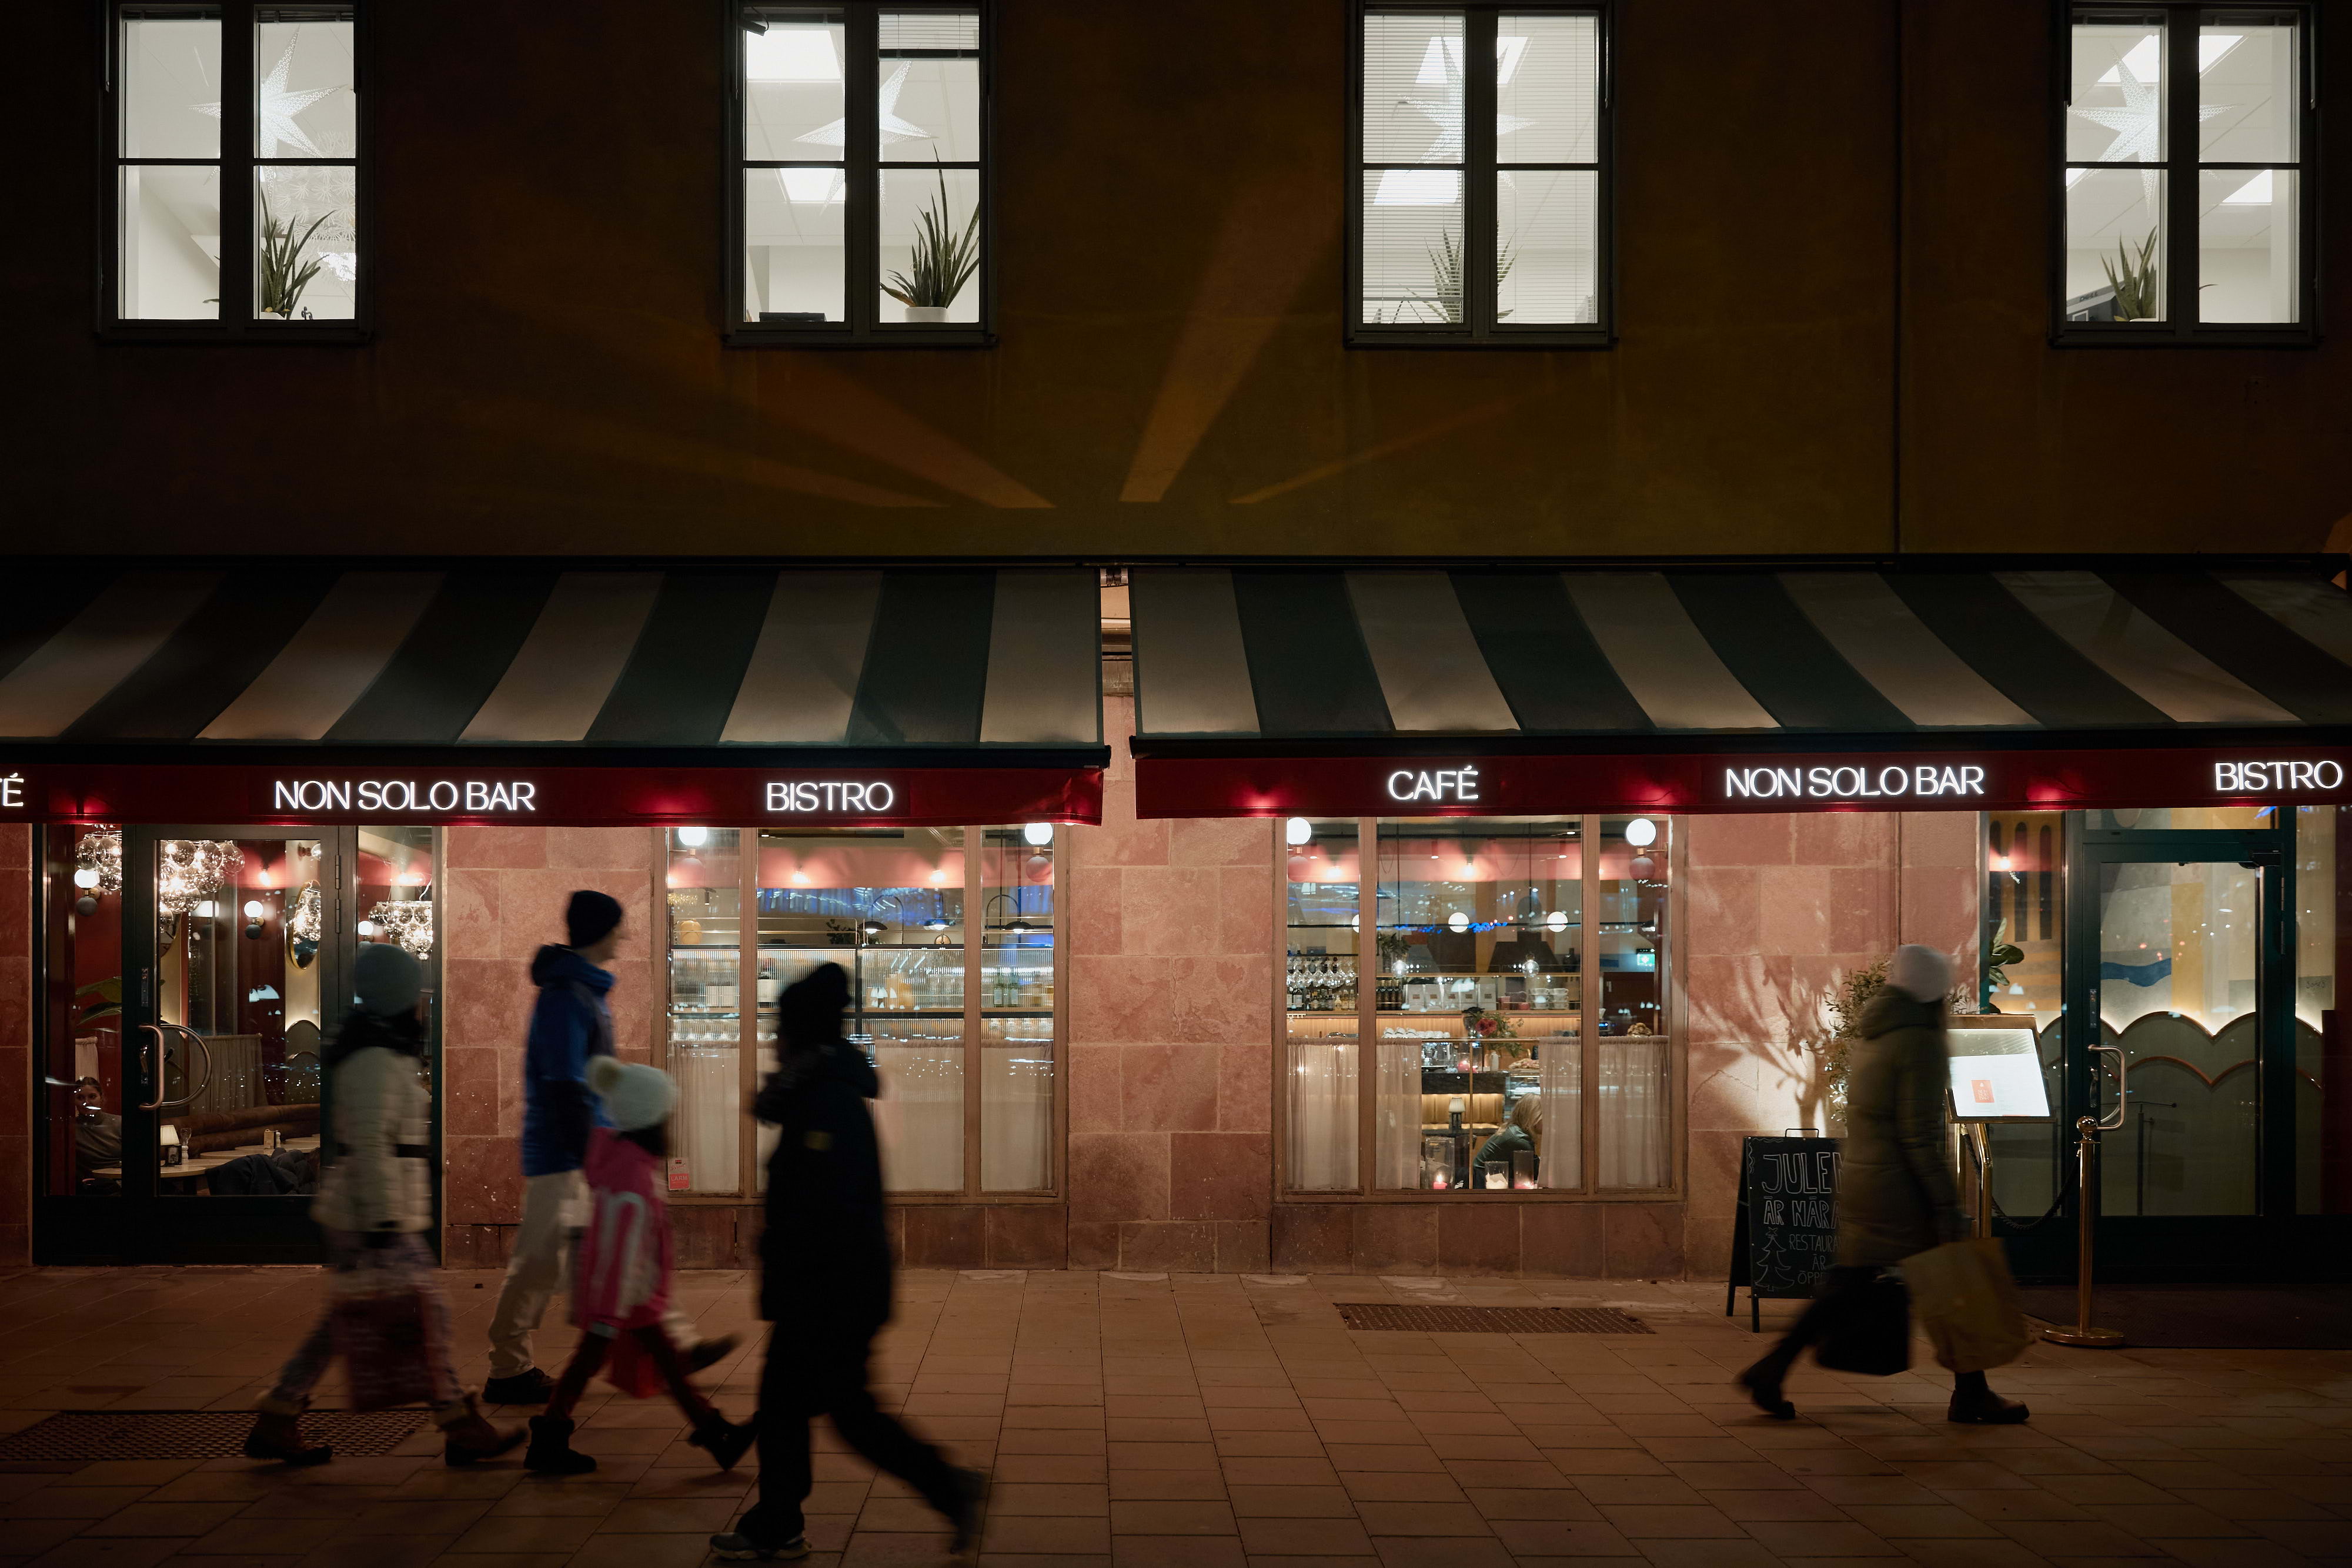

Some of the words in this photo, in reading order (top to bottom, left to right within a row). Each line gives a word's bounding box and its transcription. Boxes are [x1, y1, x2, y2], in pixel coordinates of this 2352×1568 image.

[1387, 765, 1479, 801] CAFÉ
[1726, 768, 1801, 797] NON
[1808, 767, 1909, 797] SOLO
[1915, 766, 1984, 795] BAR
[2215, 760, 2343, 791] BISTRO
[275, 781, 350, 810] NON
[358, 781, 459, 810] SOLO
[466, 781, 536, 811] BAR
[766, 782, 894, 811] BISTRO
